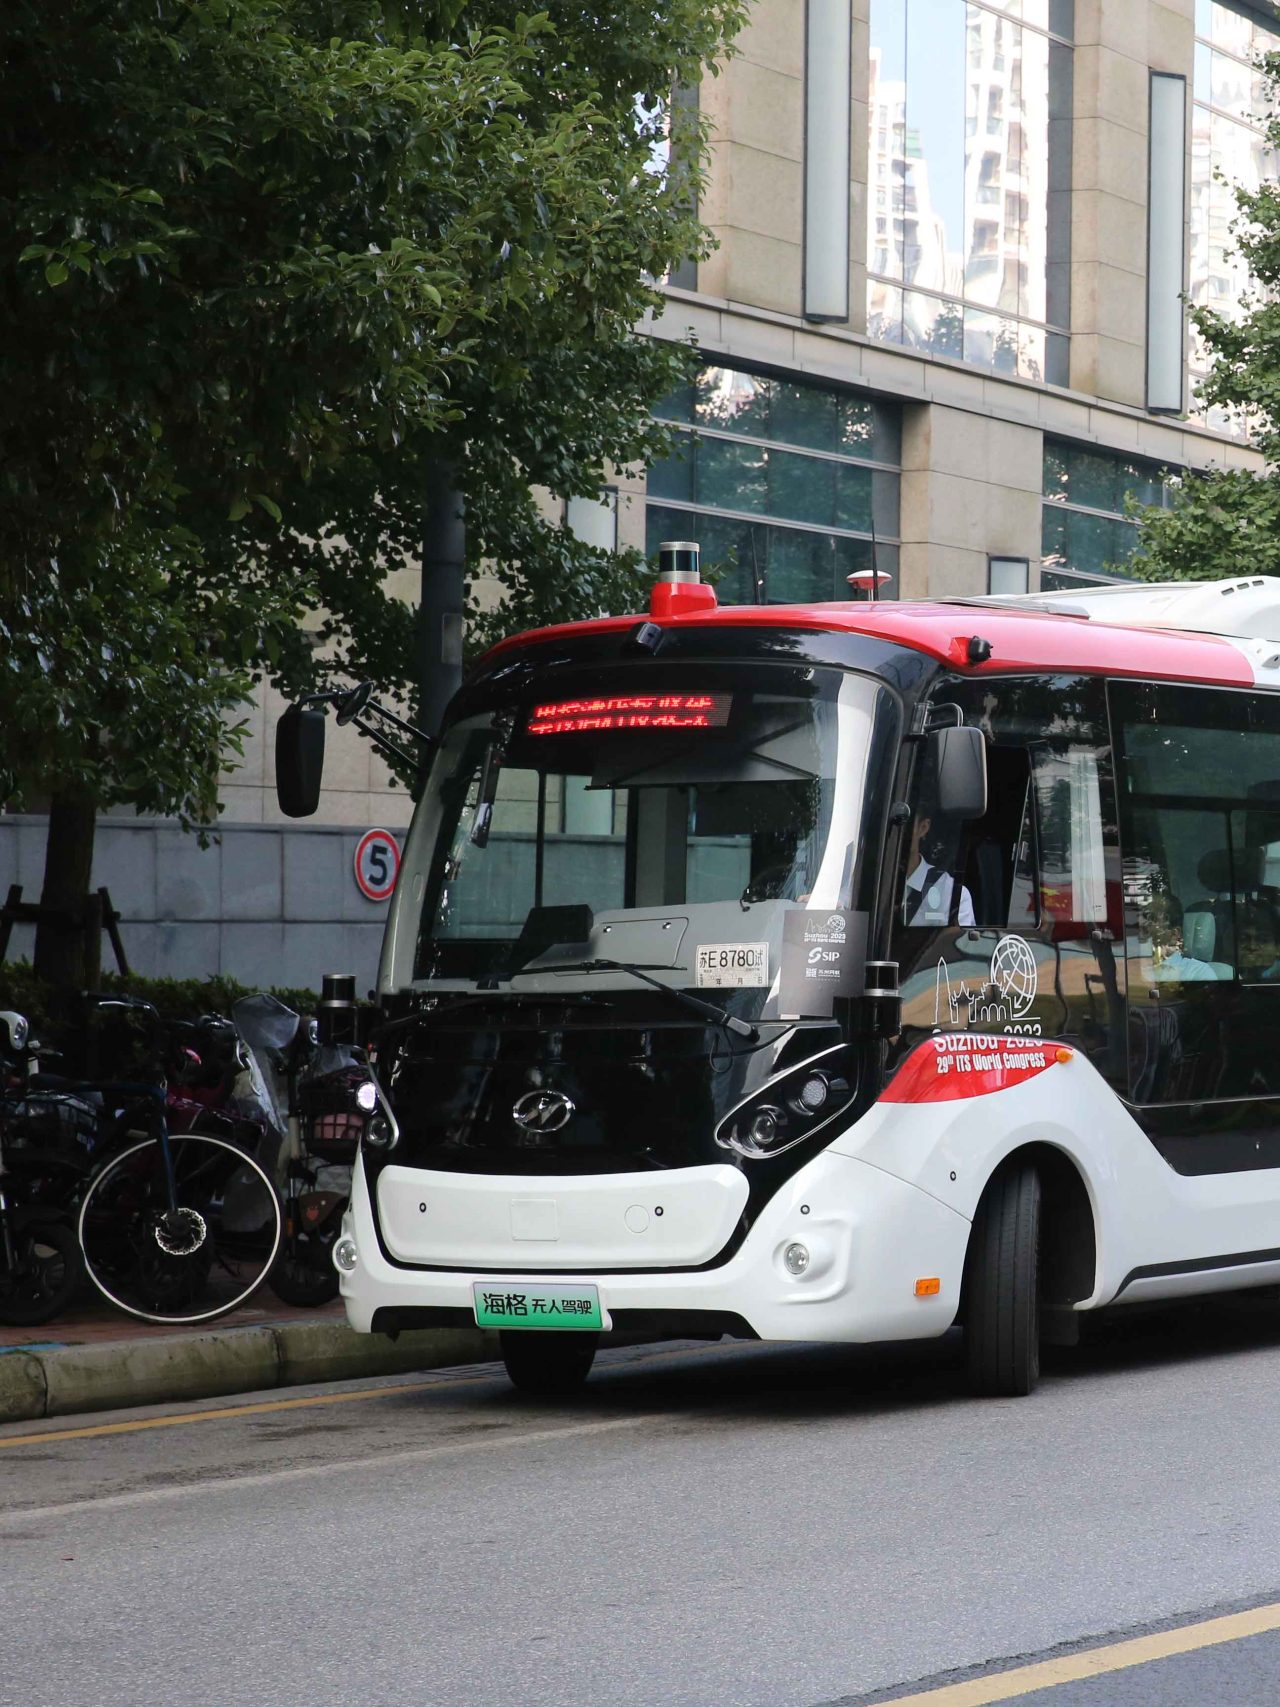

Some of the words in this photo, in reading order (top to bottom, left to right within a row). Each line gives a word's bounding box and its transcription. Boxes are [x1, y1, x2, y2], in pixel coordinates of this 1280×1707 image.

[368, 844, 388, 886] 5
[822, 951, 840, 962] SIP
[932, 1028, 998, 1052] Suzhou
[1004, 1023, 1043, 1048] 2023
[937, 1055, 954, 1073] 29th
[956, 1054, 971, 1072] ITS
[972, 1052, 1002, 1071] World
[1003, 1052, 1045, 1069] Congress
[483, 1293, 528, 1316] 海格
[532, 1299, 592, 1315] 无人驾驶
